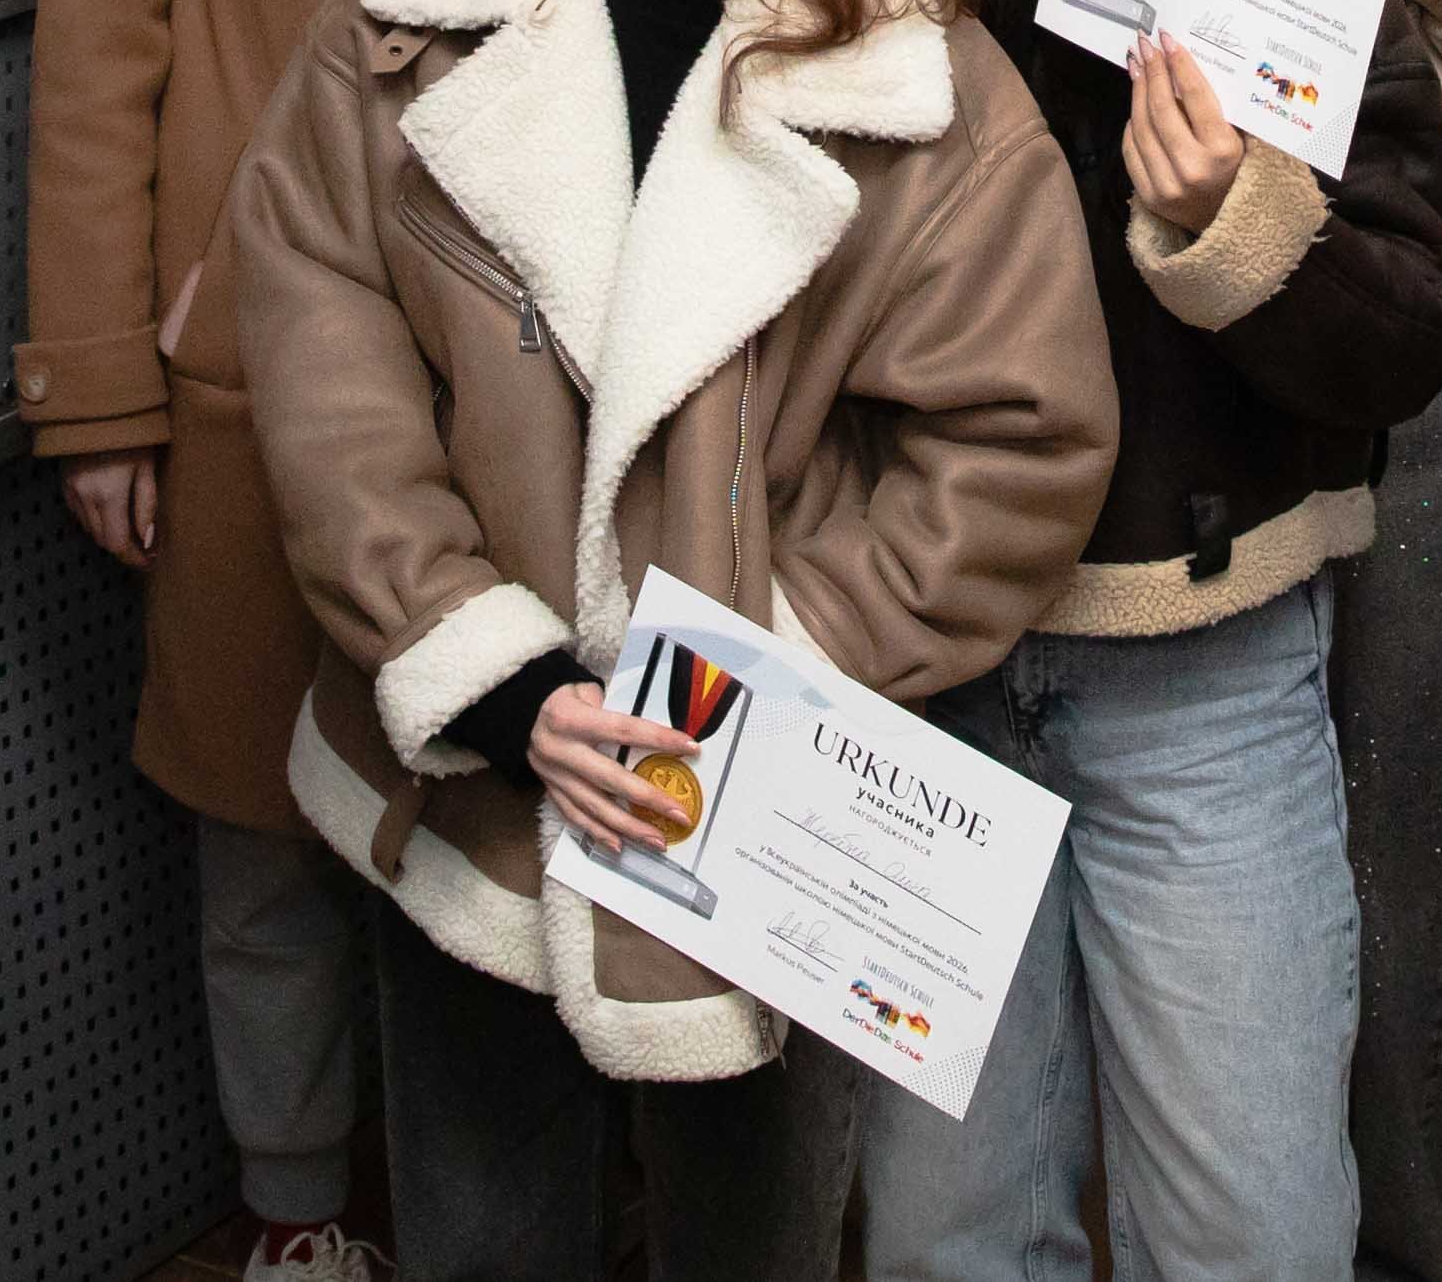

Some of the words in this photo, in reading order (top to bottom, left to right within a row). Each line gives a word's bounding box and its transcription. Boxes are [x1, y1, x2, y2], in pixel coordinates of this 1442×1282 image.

[1289, 112, 1312, 131] Schule
[813, 722, 991, 847] URKUNDE
[848, 804, 931, 857] НАГОРОДЖУЄТЬСЯ
[855, 786, 934, 838] учасника
[734, 847, 793, 885] організованій
[793, 881, 831, 908] школою
[831, 905, 875, 934] німецької
[874, 932, 899, 949] мови
[899, 944, 954, 983] StartDeutsch
[954, 978, 983, 1001] Schule
[829, 886, 871, 915] олімпіаді
[877, 916, 920, 944] німецької
[921, 942, 945, 959] мови
[859, 887, 888, 908] участь
[766, 943, 795, 968] Markus
[796, 962, 825, 984] Peuser
[842, 1007, 891, 1044] DerDieDas
[893, 1039, 924, 1063] Schule
